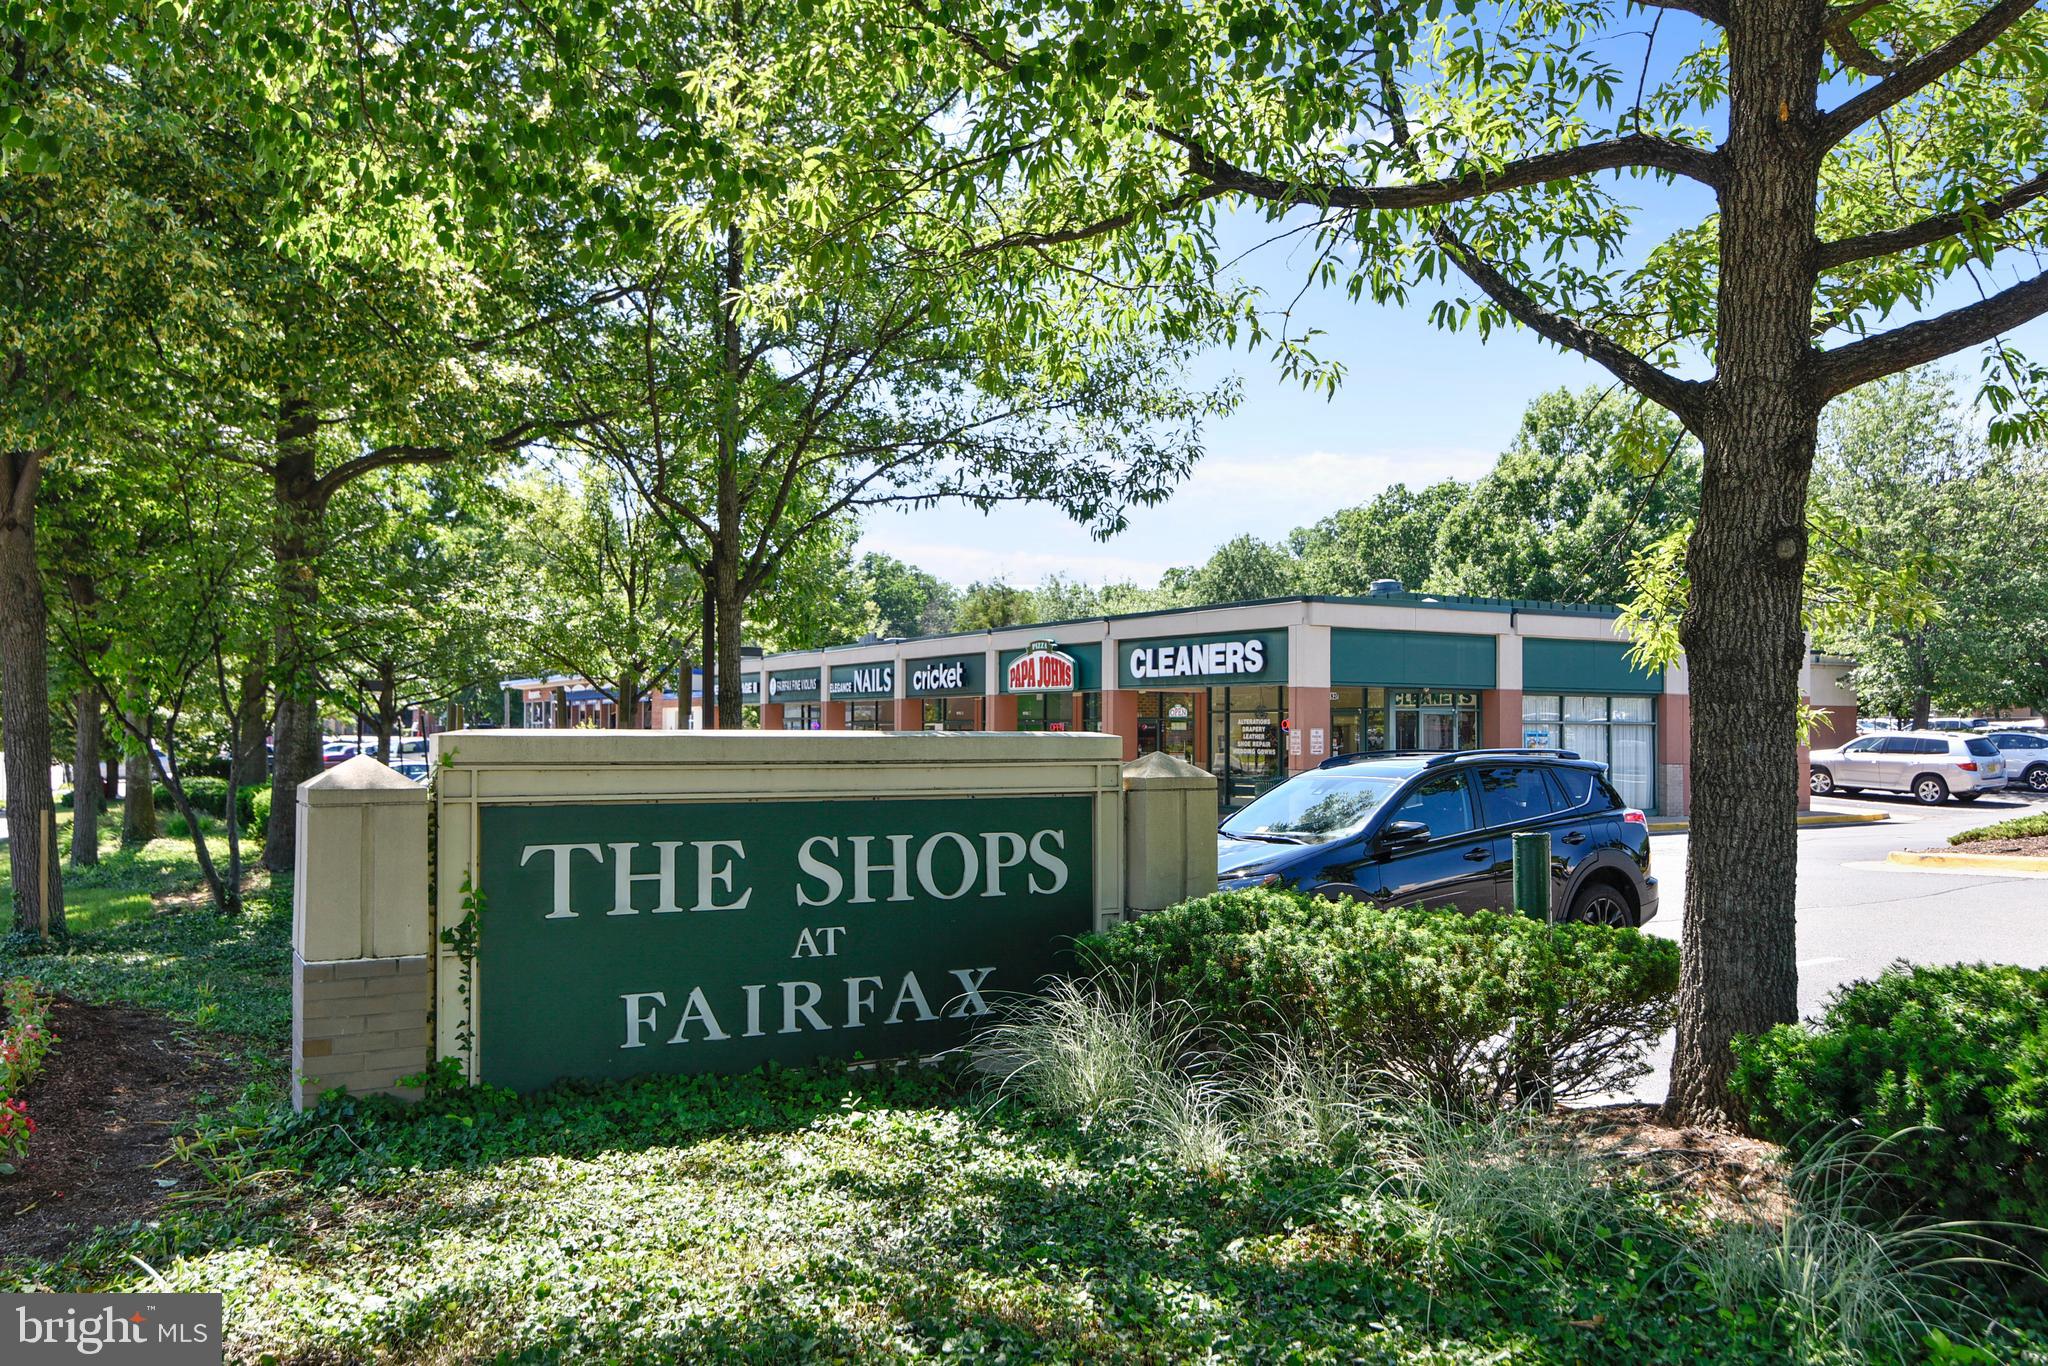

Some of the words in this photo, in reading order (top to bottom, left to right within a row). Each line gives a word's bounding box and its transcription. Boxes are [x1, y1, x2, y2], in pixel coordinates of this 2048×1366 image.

[1031, 642, 1048, 650] PIZZA
[1130, 640, 1264, 678] CLEANERS
[829, 682, 852, 693] ELEGANCE
[853, 668, 892, 693] NAILS
[913, 662, 963, 690] cricket
[1010, 658, 1036, 688] PAPA
[1395, 693, 1472, 705] CLEANES
[521, 840, 753, 919] THE
[797, 829, 1068, 906] SHOPS
[792, 926, 846, 958] AT
[620, 966, 997, 1049] FAIRFAX
